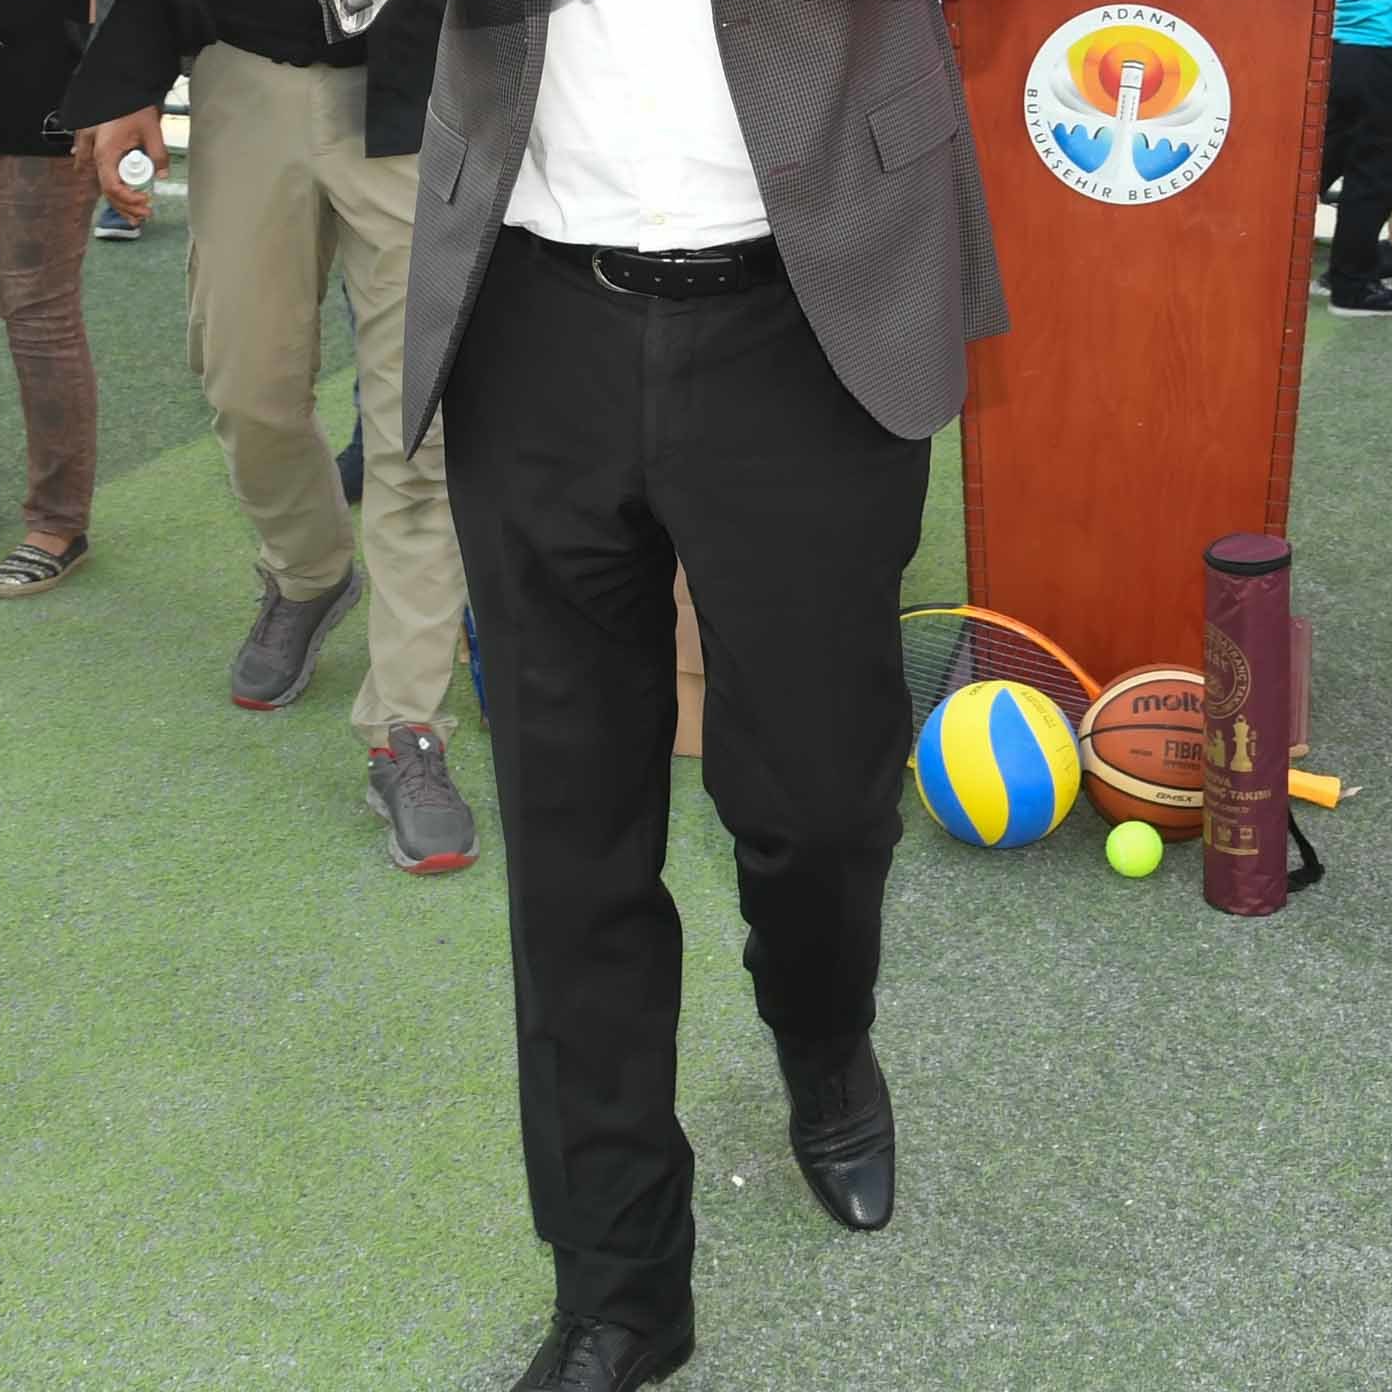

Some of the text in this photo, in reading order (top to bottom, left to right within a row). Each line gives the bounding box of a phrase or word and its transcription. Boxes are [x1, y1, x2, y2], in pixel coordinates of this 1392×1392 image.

[1101, 8, 1176, 32] ADANA
[1132, 691, 1205, 714] molt
[1164, 739, 1203, 761] FIBA
